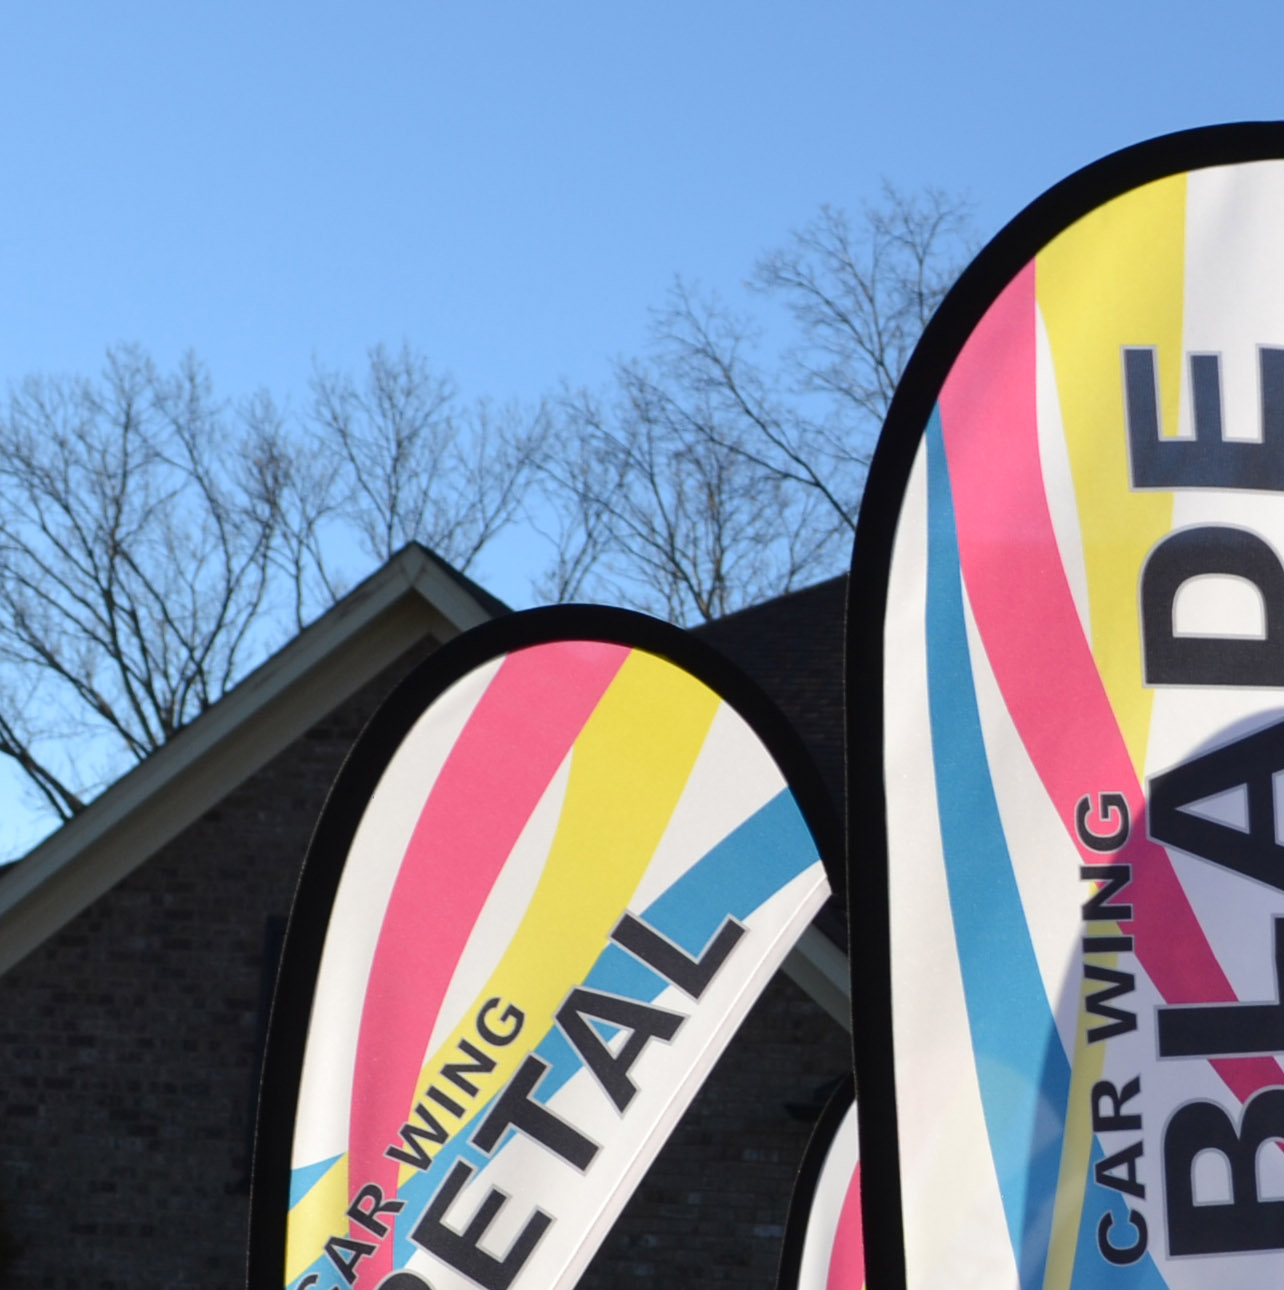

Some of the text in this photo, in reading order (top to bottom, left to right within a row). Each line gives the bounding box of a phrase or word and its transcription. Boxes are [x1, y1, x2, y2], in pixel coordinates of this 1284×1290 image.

[386, 996, 525, 1172] WING
[1073, 789, 1149, 1267] CAR WING
